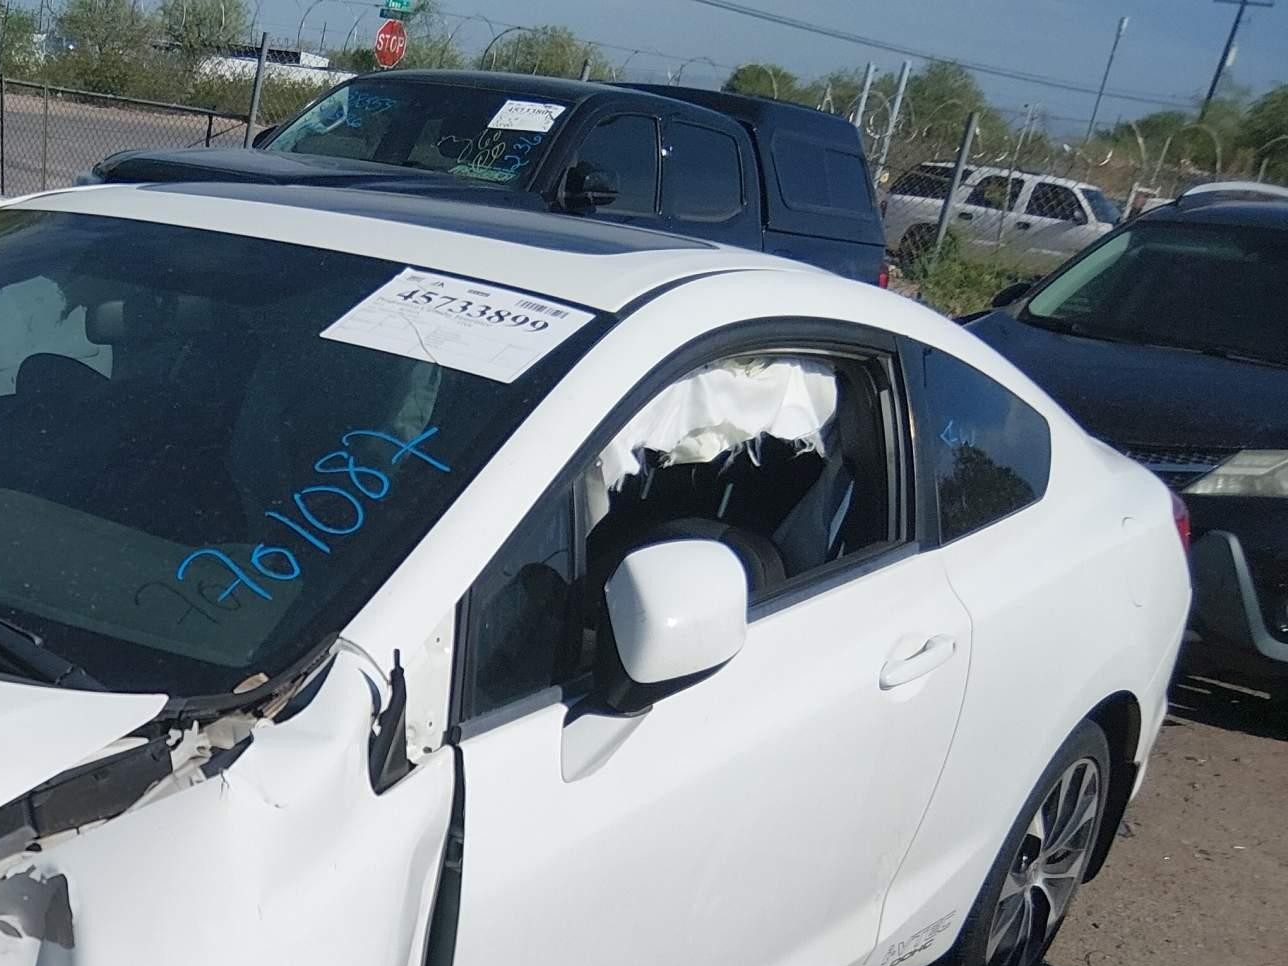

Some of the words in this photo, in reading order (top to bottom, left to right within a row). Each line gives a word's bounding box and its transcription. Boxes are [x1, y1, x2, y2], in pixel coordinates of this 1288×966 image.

[377, 34, 404, 53] STOP
[396, 288, 550, 332] 45733899
[176, 426, 452, 602] 701087
